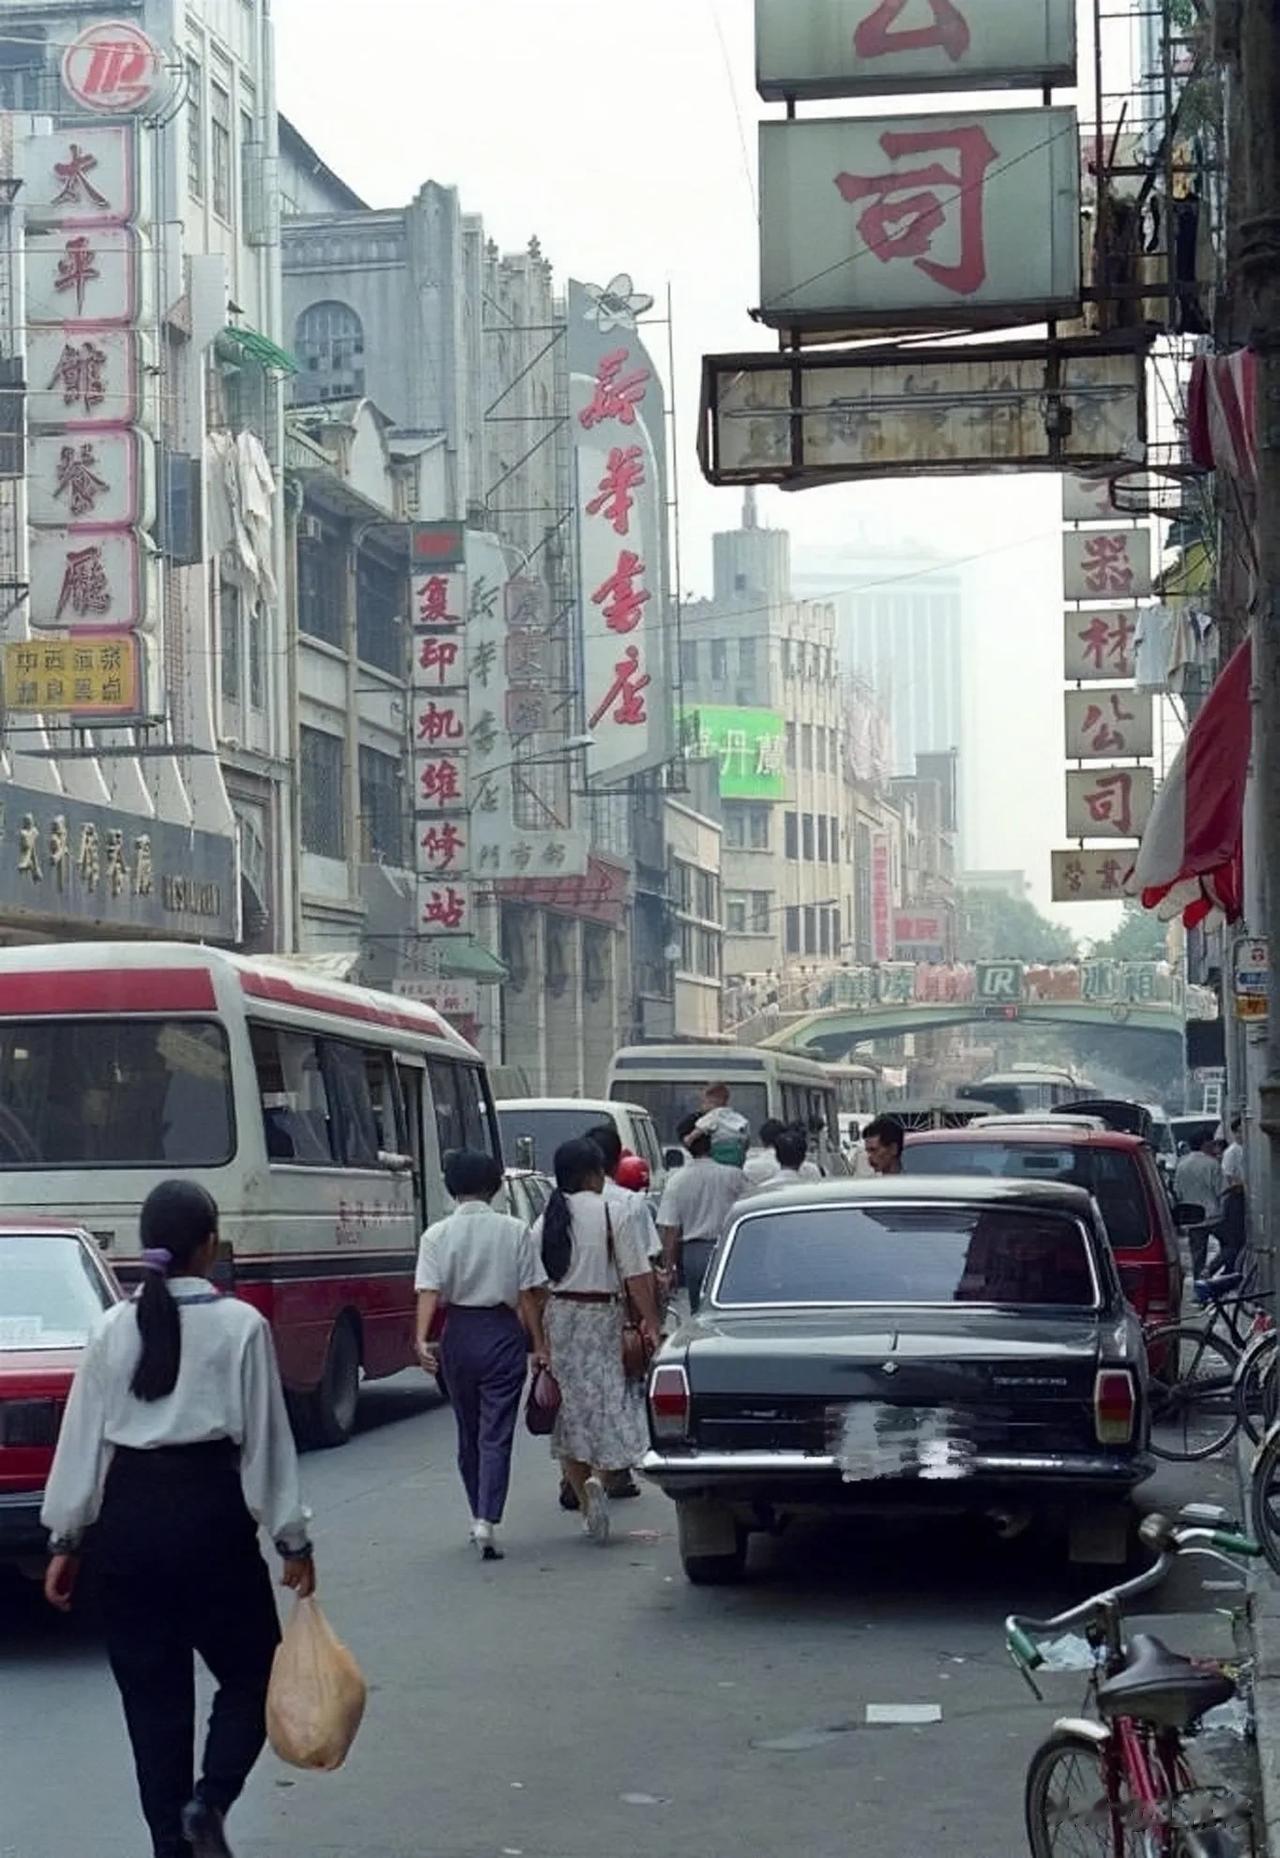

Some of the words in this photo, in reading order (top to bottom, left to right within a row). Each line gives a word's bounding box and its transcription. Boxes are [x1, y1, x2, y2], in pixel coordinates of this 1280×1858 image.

[417, 575, 466, 928] 复印机维修站
